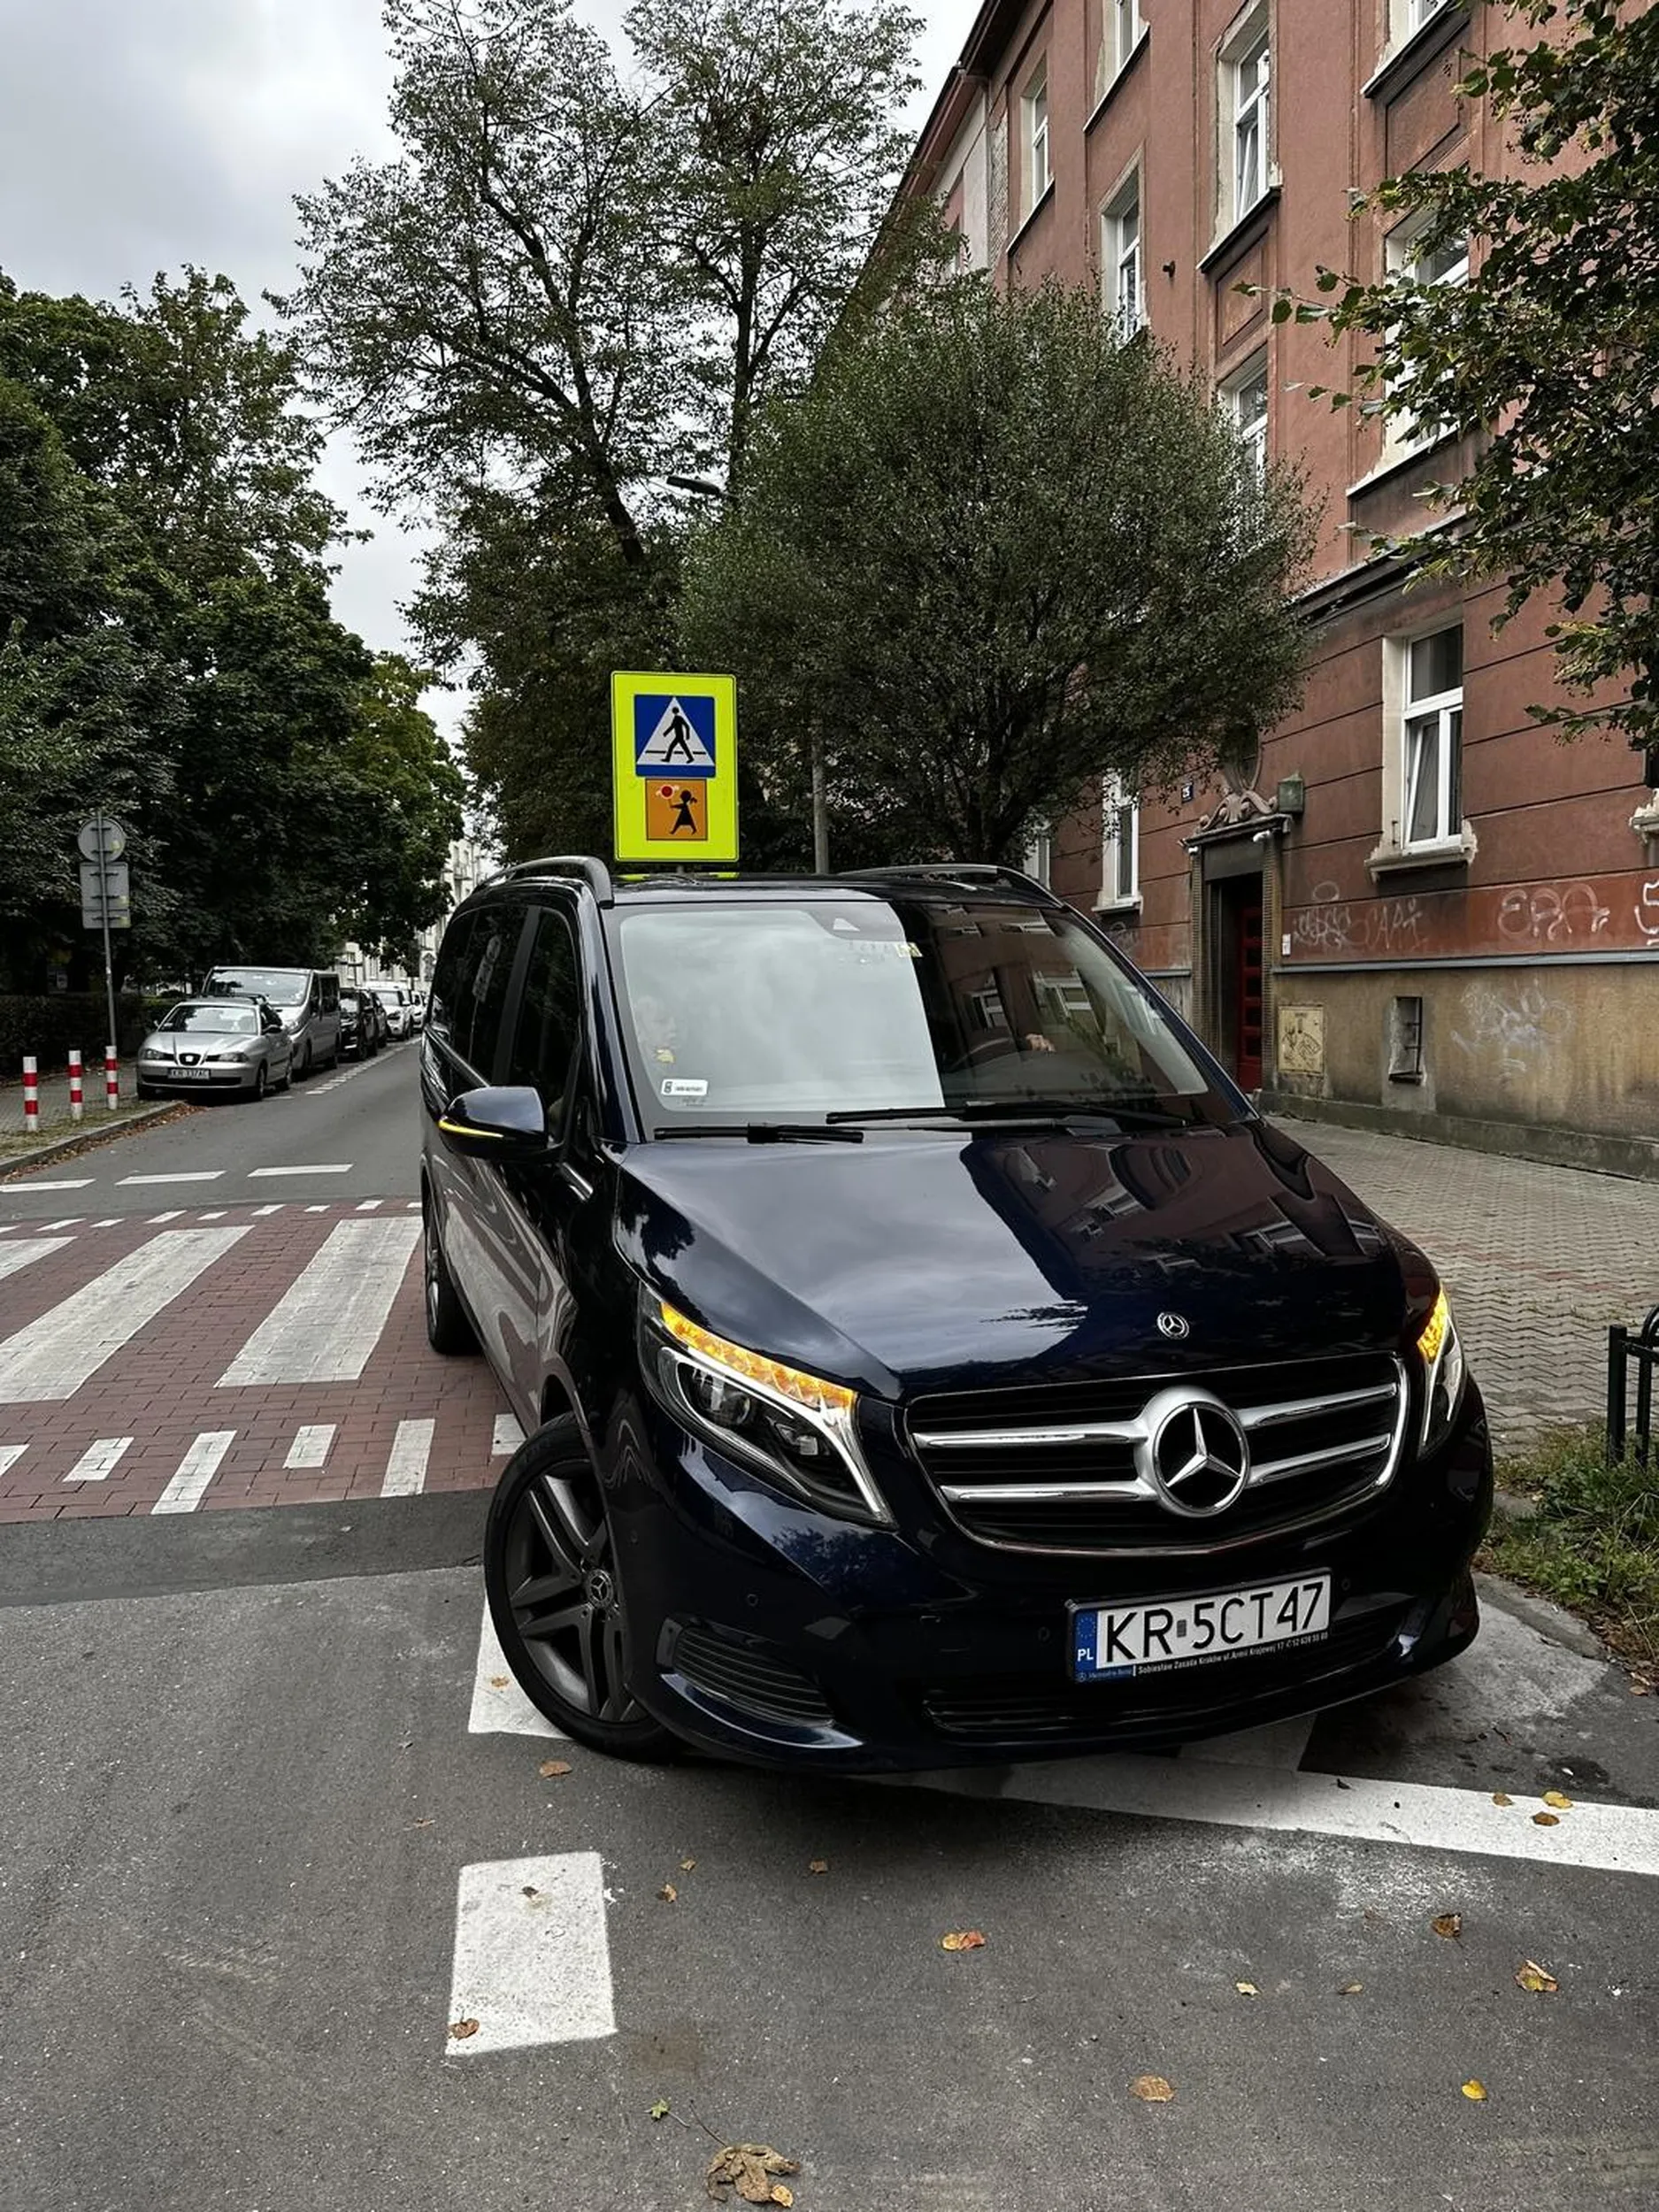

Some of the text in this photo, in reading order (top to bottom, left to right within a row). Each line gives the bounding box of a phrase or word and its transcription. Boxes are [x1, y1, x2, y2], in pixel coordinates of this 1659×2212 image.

[1106, 1580, 1325, 1663] KR 5CT47
[1077, 1647, 1094, 1662] PL
